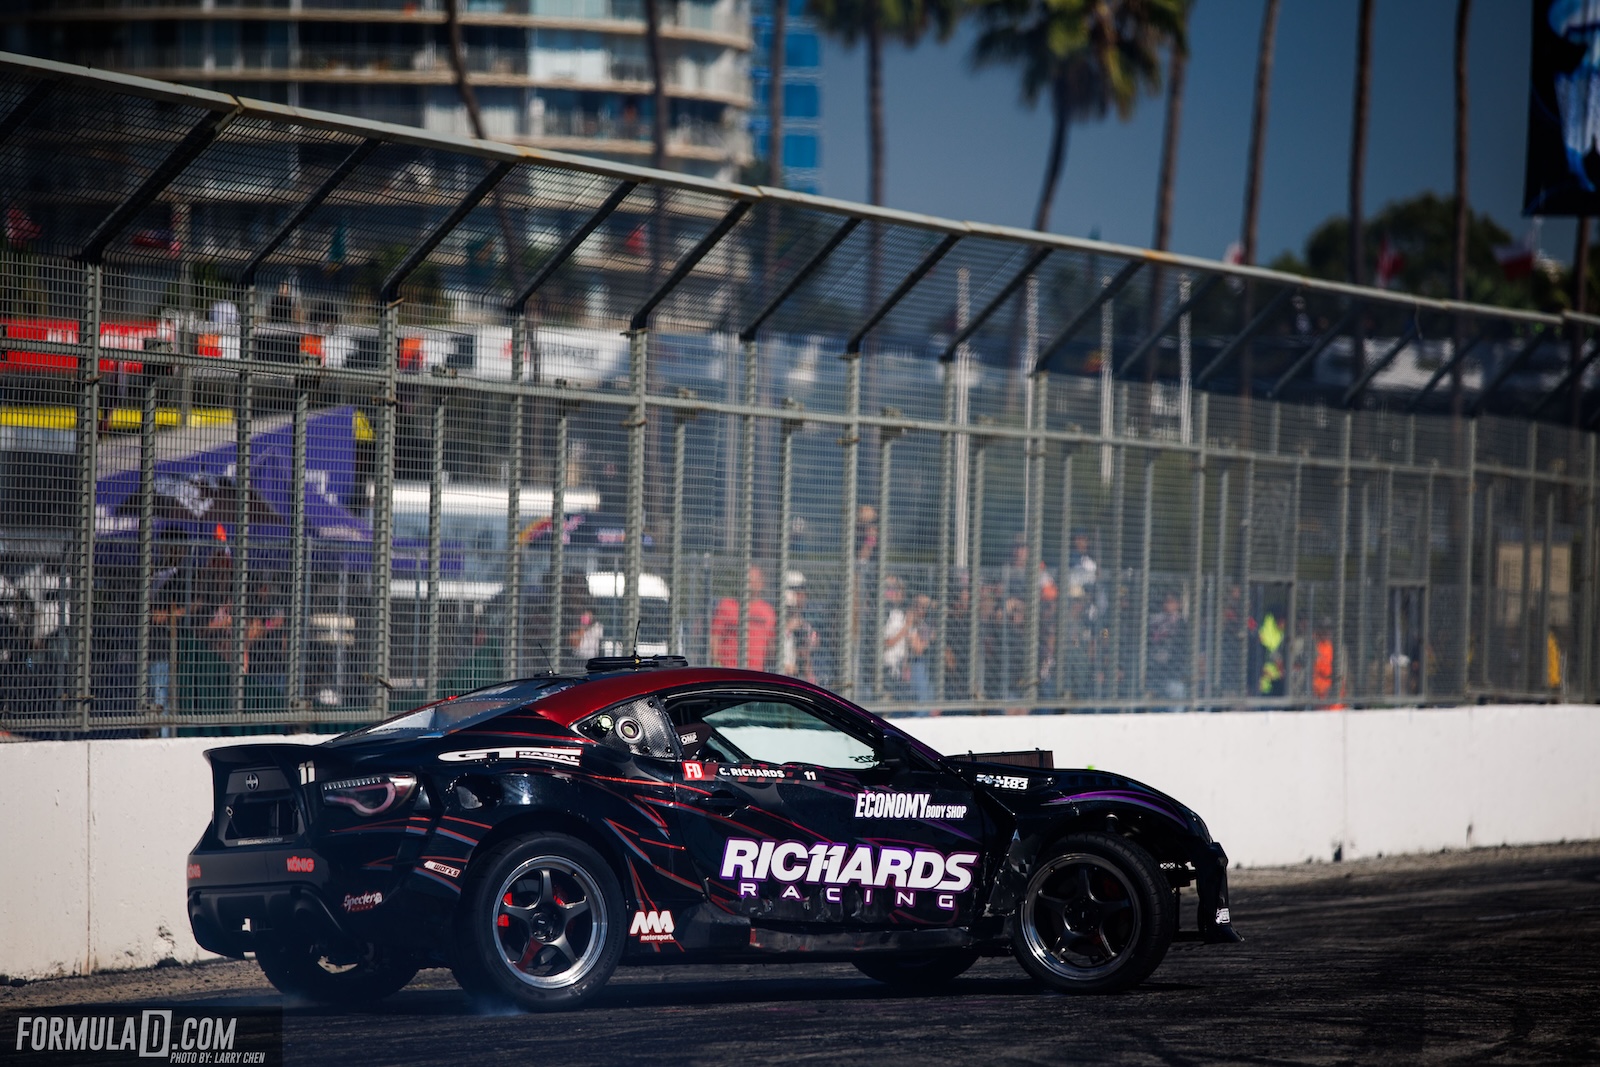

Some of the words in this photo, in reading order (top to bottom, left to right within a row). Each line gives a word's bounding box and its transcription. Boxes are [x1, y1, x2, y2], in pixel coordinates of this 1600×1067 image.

[681, 732, 698, 745] OMP
[437, 747, 517, 762] GT
[518, 751, 580, 762] RADIAL
[684, 762, 702, 779] FD
[719, 767, 731, 777] C.
[730, 767, 785, 778] RICHARDS
[803, 770, 817, 781] 11
[854, 793, 930, 818] ECONOMY
[925, 806, 946, 818] BODY
[946, 806, 967, 819] SHOP
[740, 882, 955, 908] RACING
[640, 934, 675, 942] motorsport
